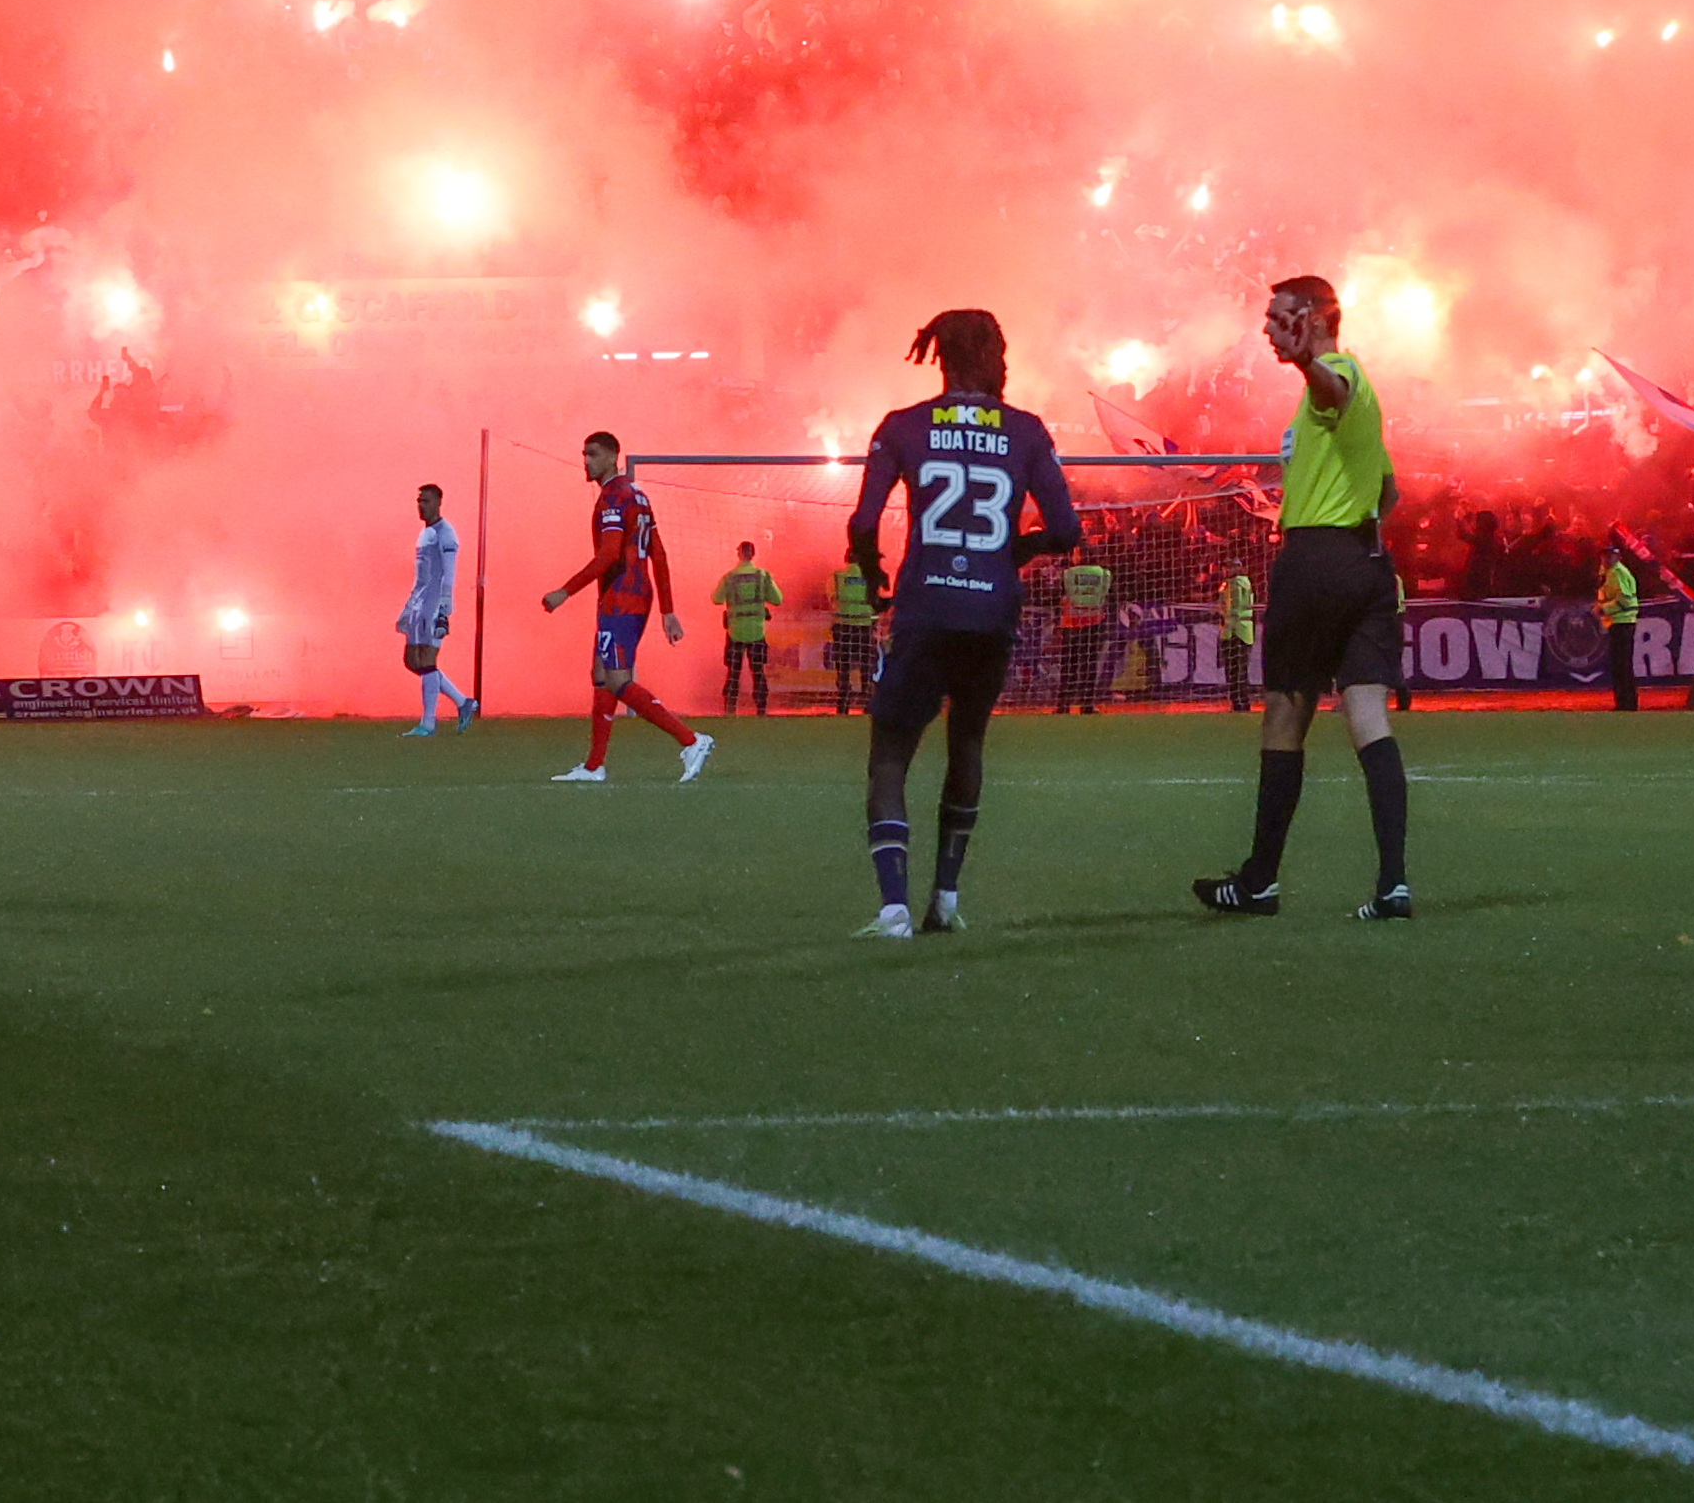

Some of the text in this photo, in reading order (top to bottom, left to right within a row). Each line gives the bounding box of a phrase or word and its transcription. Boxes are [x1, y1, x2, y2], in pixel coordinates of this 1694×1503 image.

[931, 405, 1002, 429] MKM
[928, 428, 1010, 456] BOATENG
[918, 459, 1013, 553] 23
[924, 573, 946, 586] John
[8, 676, 196, 699] CROWN
[12, 694, 198, 711] engineering services limited
